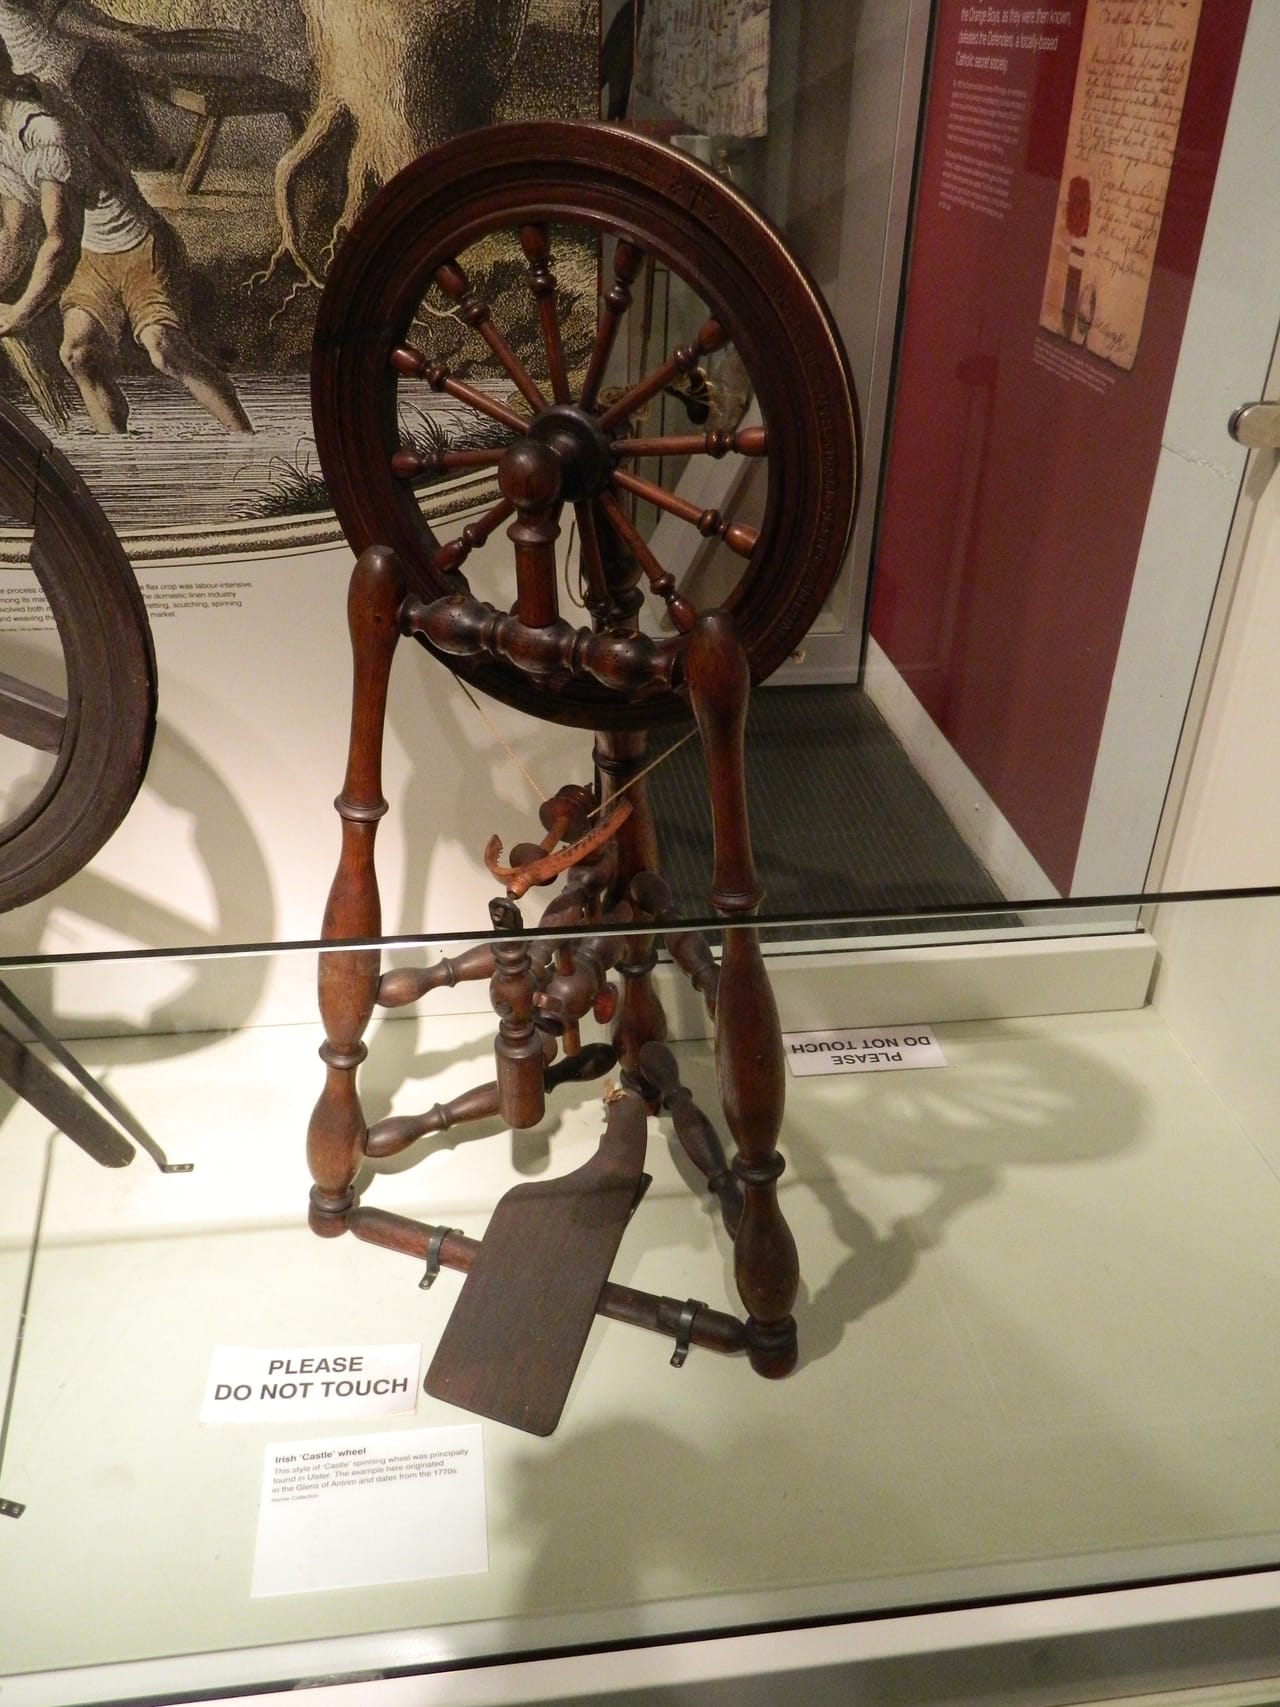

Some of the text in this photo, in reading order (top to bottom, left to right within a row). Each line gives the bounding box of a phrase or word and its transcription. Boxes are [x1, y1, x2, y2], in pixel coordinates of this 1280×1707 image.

[969, 6, 987, 25] Orange
[1009, 8, 1021, 27] they
[1021, 11, 1036, 24] were
[1036, 8, 1050, 25] then
[955, 51, 975, 68] Catholic
[974, 55, 990, 70] secret
[153, 592, 187, 600] domestic
[188, 591, 206, 599] linen
[211, 600, 242, 608] spinning
[791, 1036, 931, 1054] DO NOT TOUCH
[831, 1051, 903, 1065] PLEASE
[268, 1356, 364, 1375] PLEASE
[214, 1377, 409, 1401] DO NOT TOUCH
[275, 1455, 297, 1464] Irish
[338, 1447, 366, 1457] wheel
[275, 1467, 291, 1475] This
[292, 1465, 311, 1474] style
[353, 1457, 386, 1468] spinning
[388, 1455, 411, 1463] wheel
[412, 1453, 428, 1461] was
[430, 1448, 469, 1460] principally
[273, 1475, 296, 1485] found
[298, 1474, 305, 1482] in
[335, 1469, 350, 1478] The
[351, 1466, 384, 1476] example
[386, 1463, 404, 1472] here
[405, 1459, 444, 1470] originated
[272, 1486, 280, 1494] in
[281, 1483, 295, 1492] the
[296, 1482, 320, 1491] Glens
[321, 1480, 330, 1489] of
[331, 1478, 357, 1488] Antrim
[358, 1475, 374, 1485] and
[376, 1473, 398, 1483] dates
[399, 1471, 418, 1480] from
[419, 1470, 432, 1478] the
